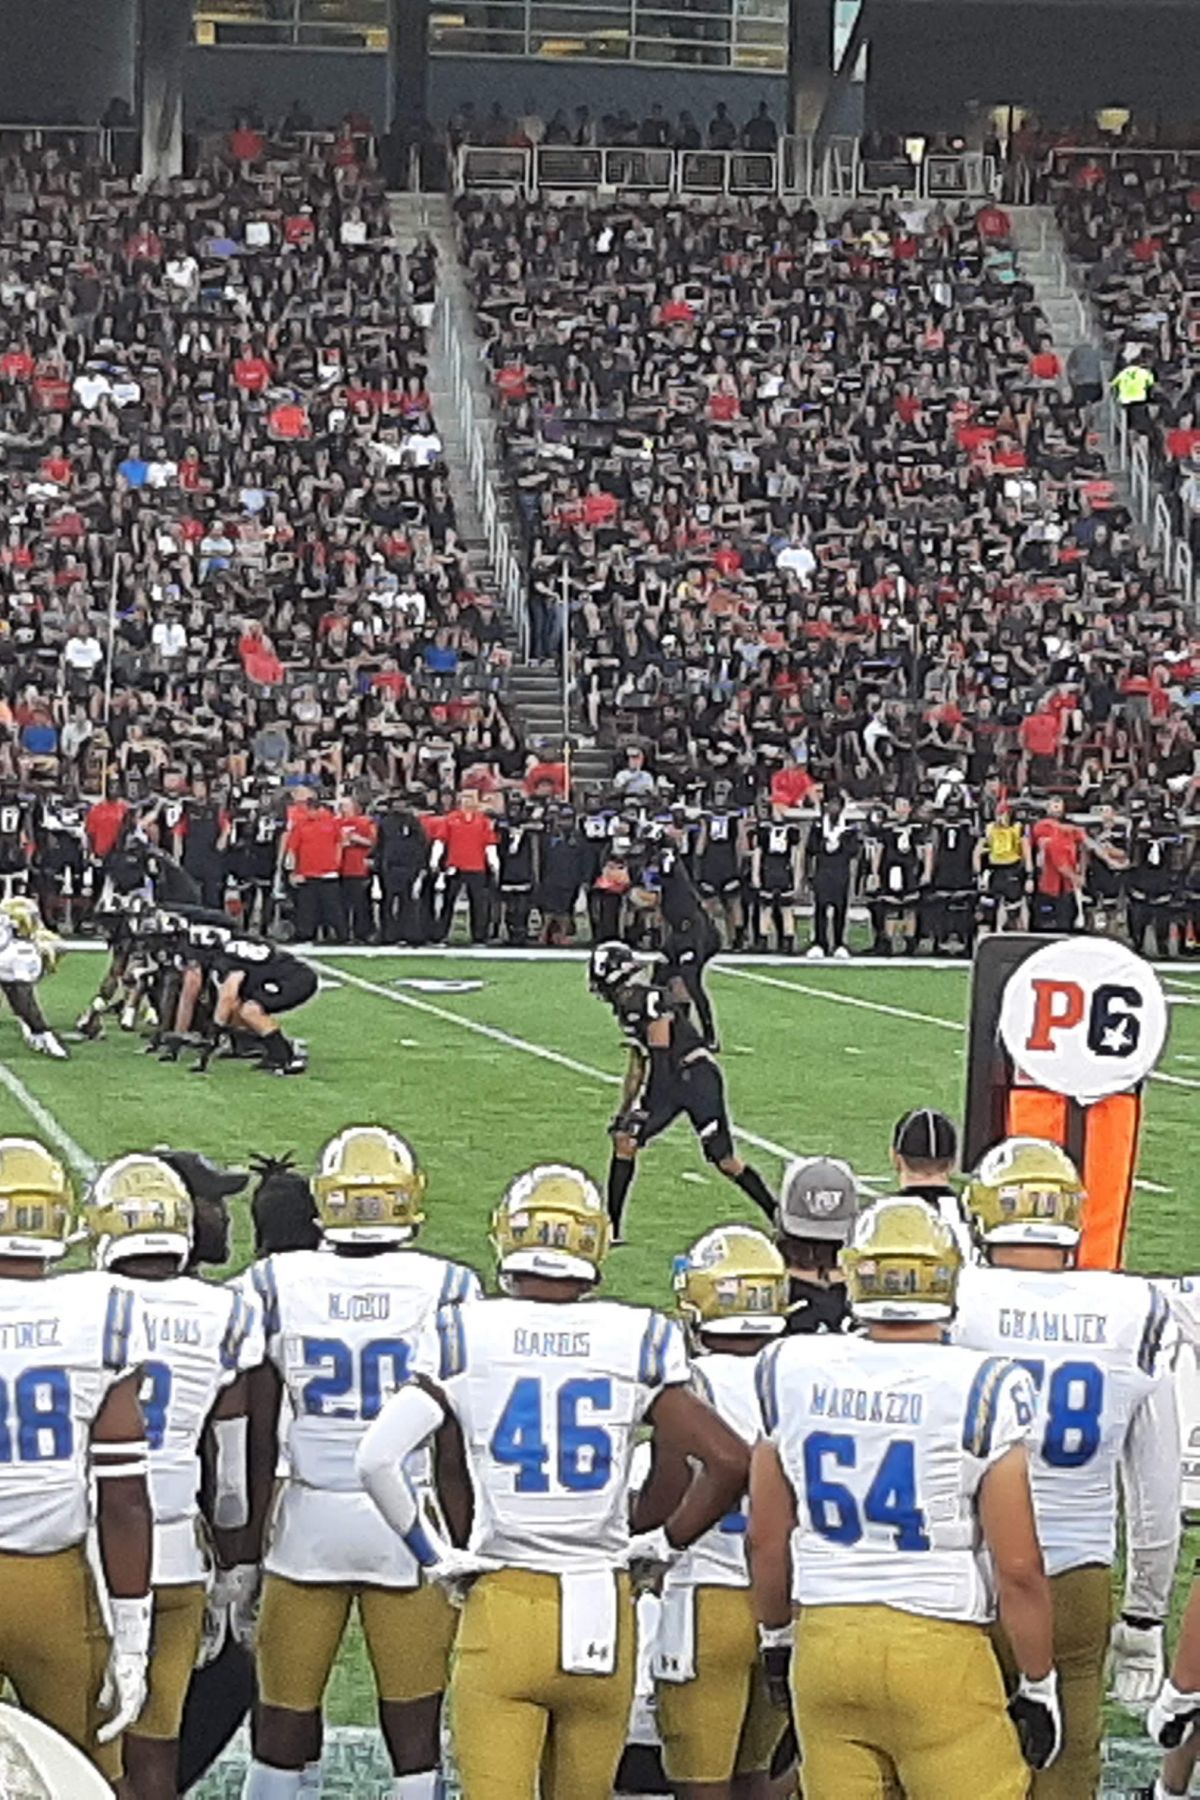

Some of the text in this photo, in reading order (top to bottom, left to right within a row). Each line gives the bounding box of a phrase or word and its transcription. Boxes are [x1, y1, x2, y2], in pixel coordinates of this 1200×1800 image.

[1025, 977, 1144, 1058] P6
[490, 1377, 612, 1492] 46
[803, 1431, 930, 1551] 64
